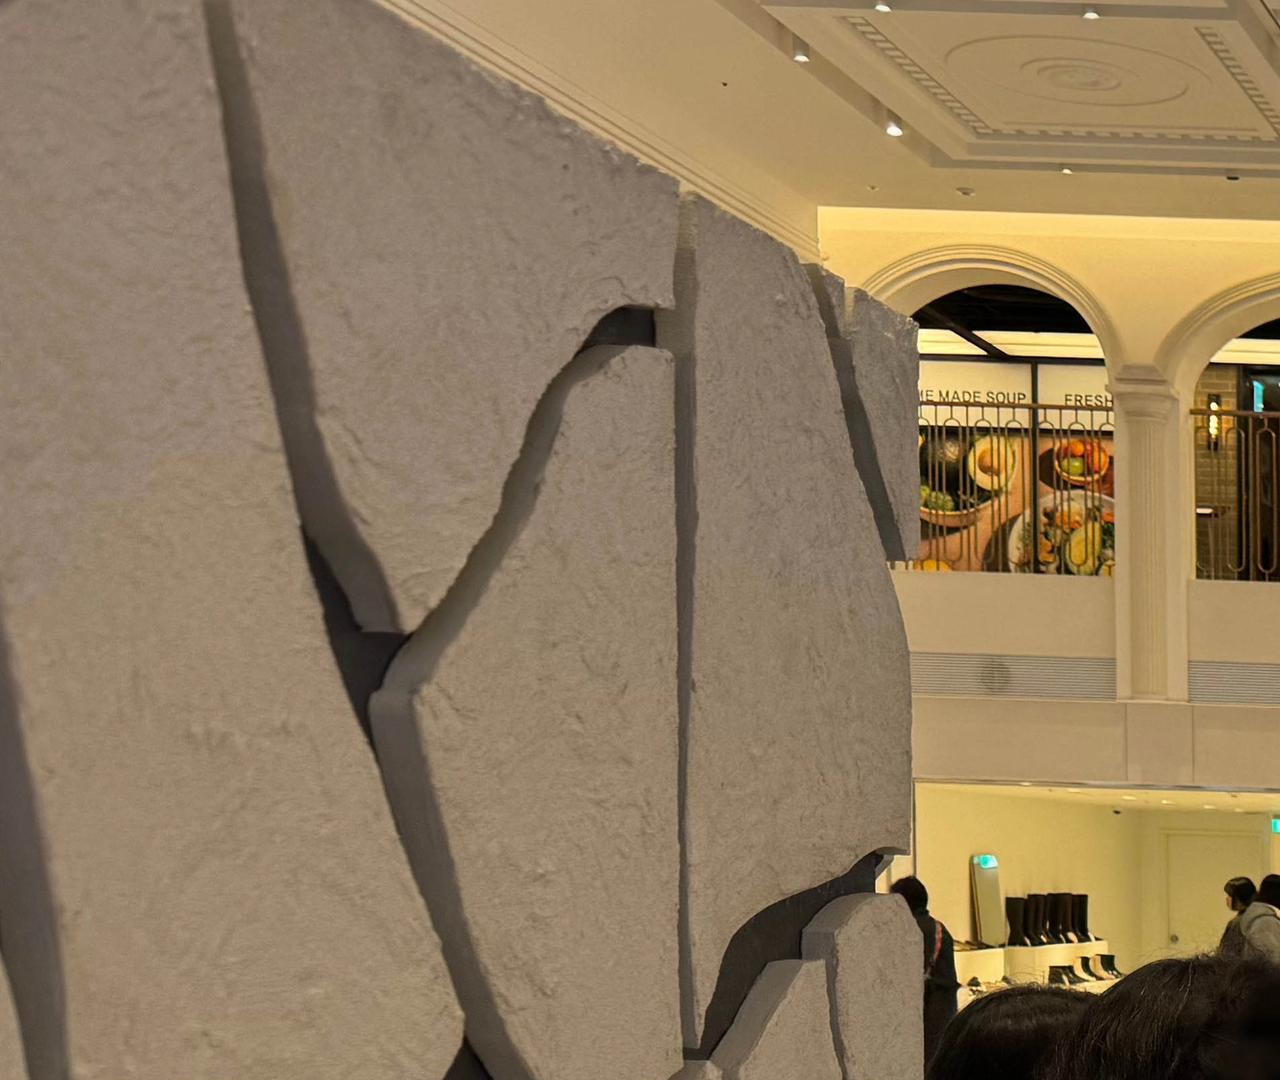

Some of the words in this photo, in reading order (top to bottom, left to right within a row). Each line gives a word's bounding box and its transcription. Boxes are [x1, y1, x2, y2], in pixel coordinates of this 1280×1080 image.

[938, 389, 982, 404] MADE
[986, 391, 1026, 405] SOUP
[1064, 393, 1114, 407] FRESH
